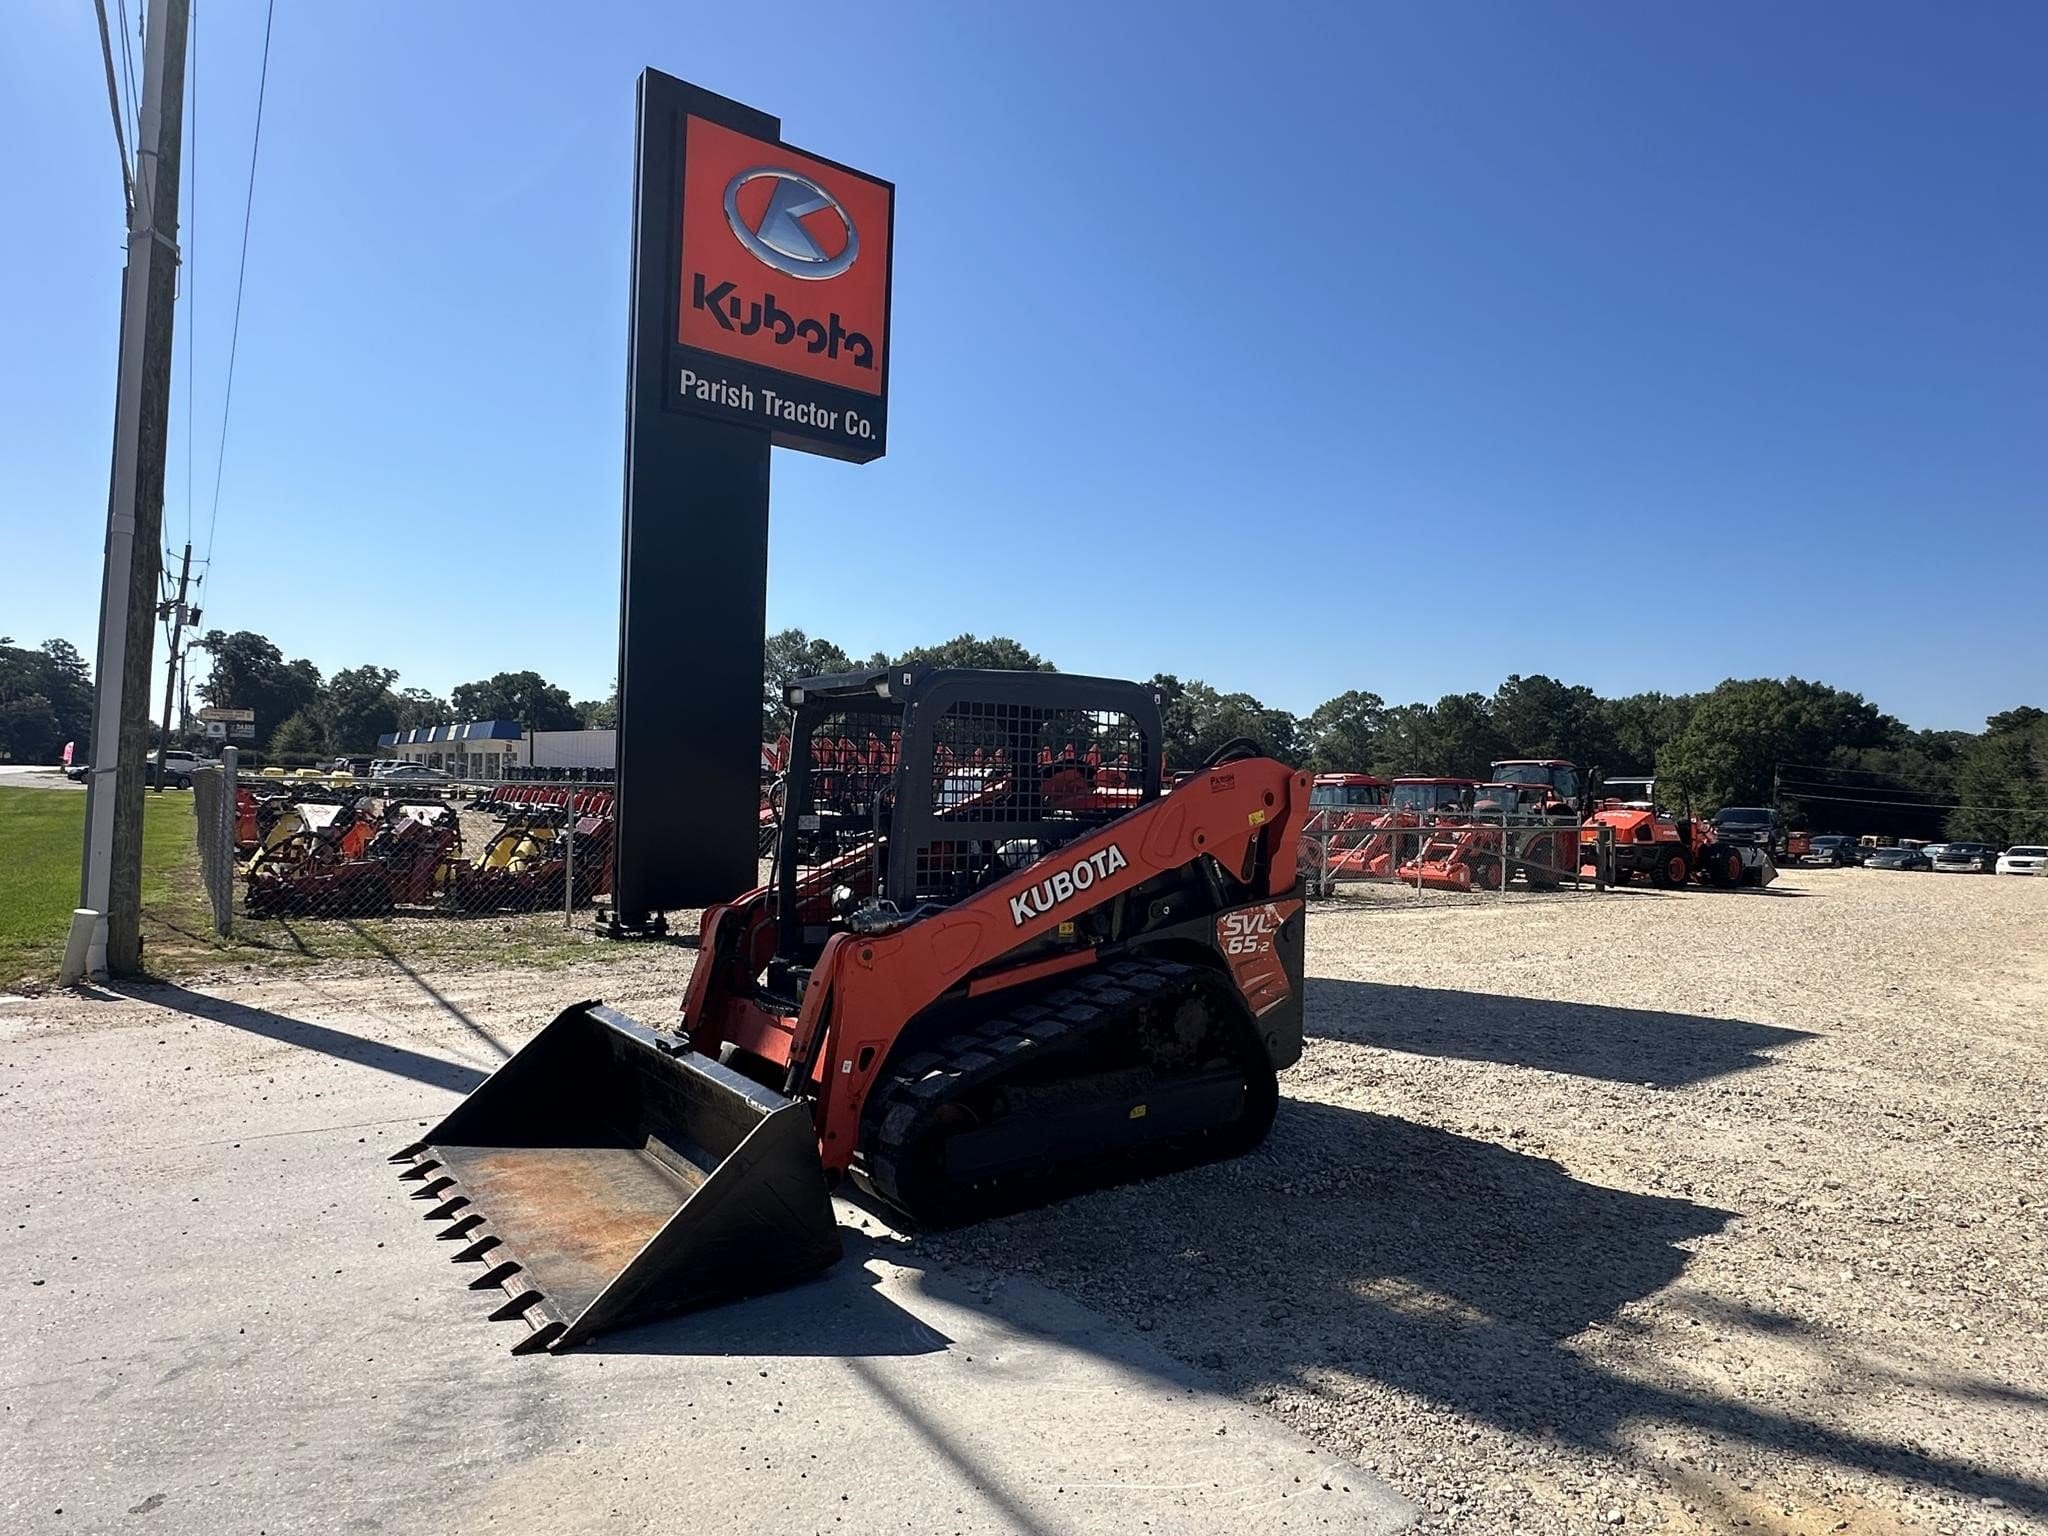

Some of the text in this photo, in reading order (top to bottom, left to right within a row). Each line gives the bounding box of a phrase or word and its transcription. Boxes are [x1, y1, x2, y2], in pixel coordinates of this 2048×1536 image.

[693, 272, 874, 370] Kubota
[680, 368, 877, 440] Parish Tractor Co.
[1008, 843, 1128, 927] KUBOTA
[1223, 914, 1274, 936] SVL
[1226, 936, 1271, 954] 65-2
